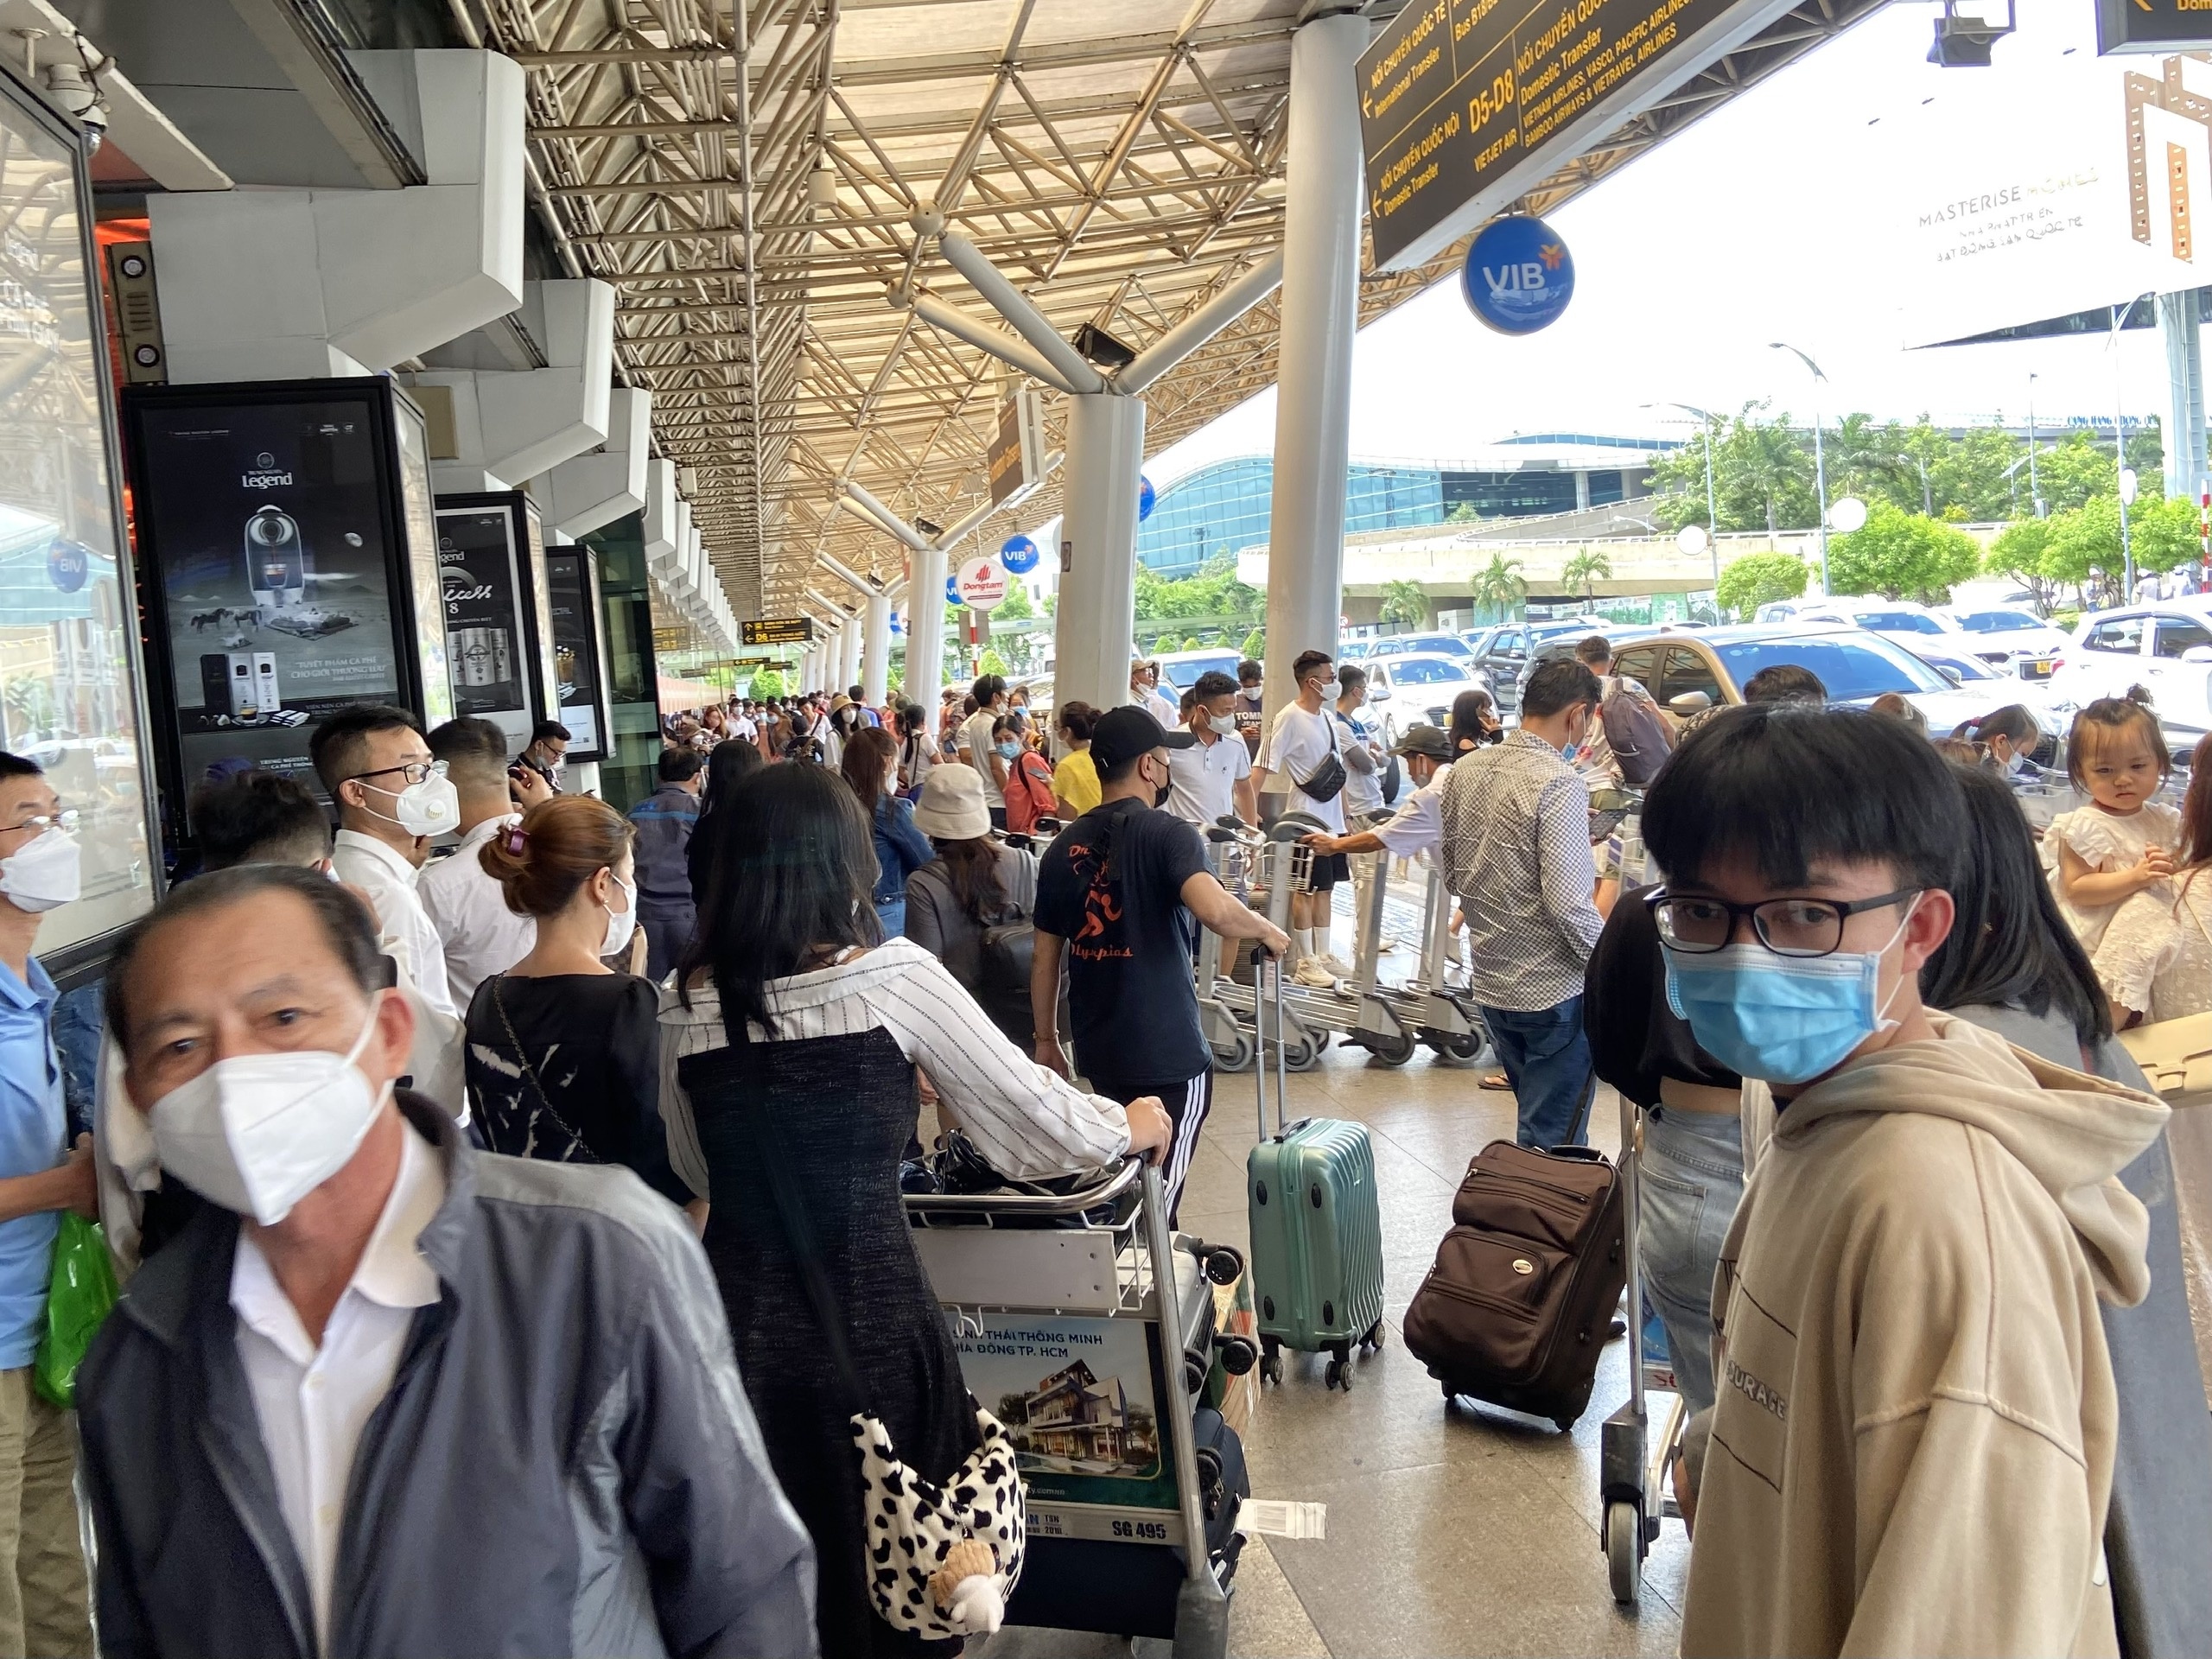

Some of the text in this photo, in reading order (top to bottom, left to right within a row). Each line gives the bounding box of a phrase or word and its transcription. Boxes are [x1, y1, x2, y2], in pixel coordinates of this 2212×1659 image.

[1455, 17, 1471, 41] Bus
[1521, 27, 1602, 105] Domestic Transfer
[1522, 96, 1553, 129] VIETNAM
[1586, 48, 1615, 79] VASCO,
[1615, 20, 1649, 56] PACIFIC
[1375, 47, 1441, 119] International Transfer
[1525, 22, 1677, 148] BAMBOO AIRWAYS & VIETRAVEL AIRLINES
[1469, 68, 1514, 133] D5-D8
[1474, 128, 1518, 172] VIETJET AIR
[1383, 162, 1439, 216] Domestic Transfer
[1919, 185, 2022, 227] MASTERISE
[1482, 263, 1545, 292] VIB
[241, 472, 293, 490] Legend
[1005, 550, 1027, 561] VIB
[449, 602, 459, 613] 8
[755, 632, 769, 642] D6
[977, 1342, 1015, 1355] ĐÔNG
[1017, 1345, 1036, 1357] TP.
[1040, 1347, 1068, 1357] HCM
[1018, 1331, 1065, 1343] THÔNG
[1069, 1334, 1103, 1344] MINH
[1112, 1520, 1166, 1540] SG 495
